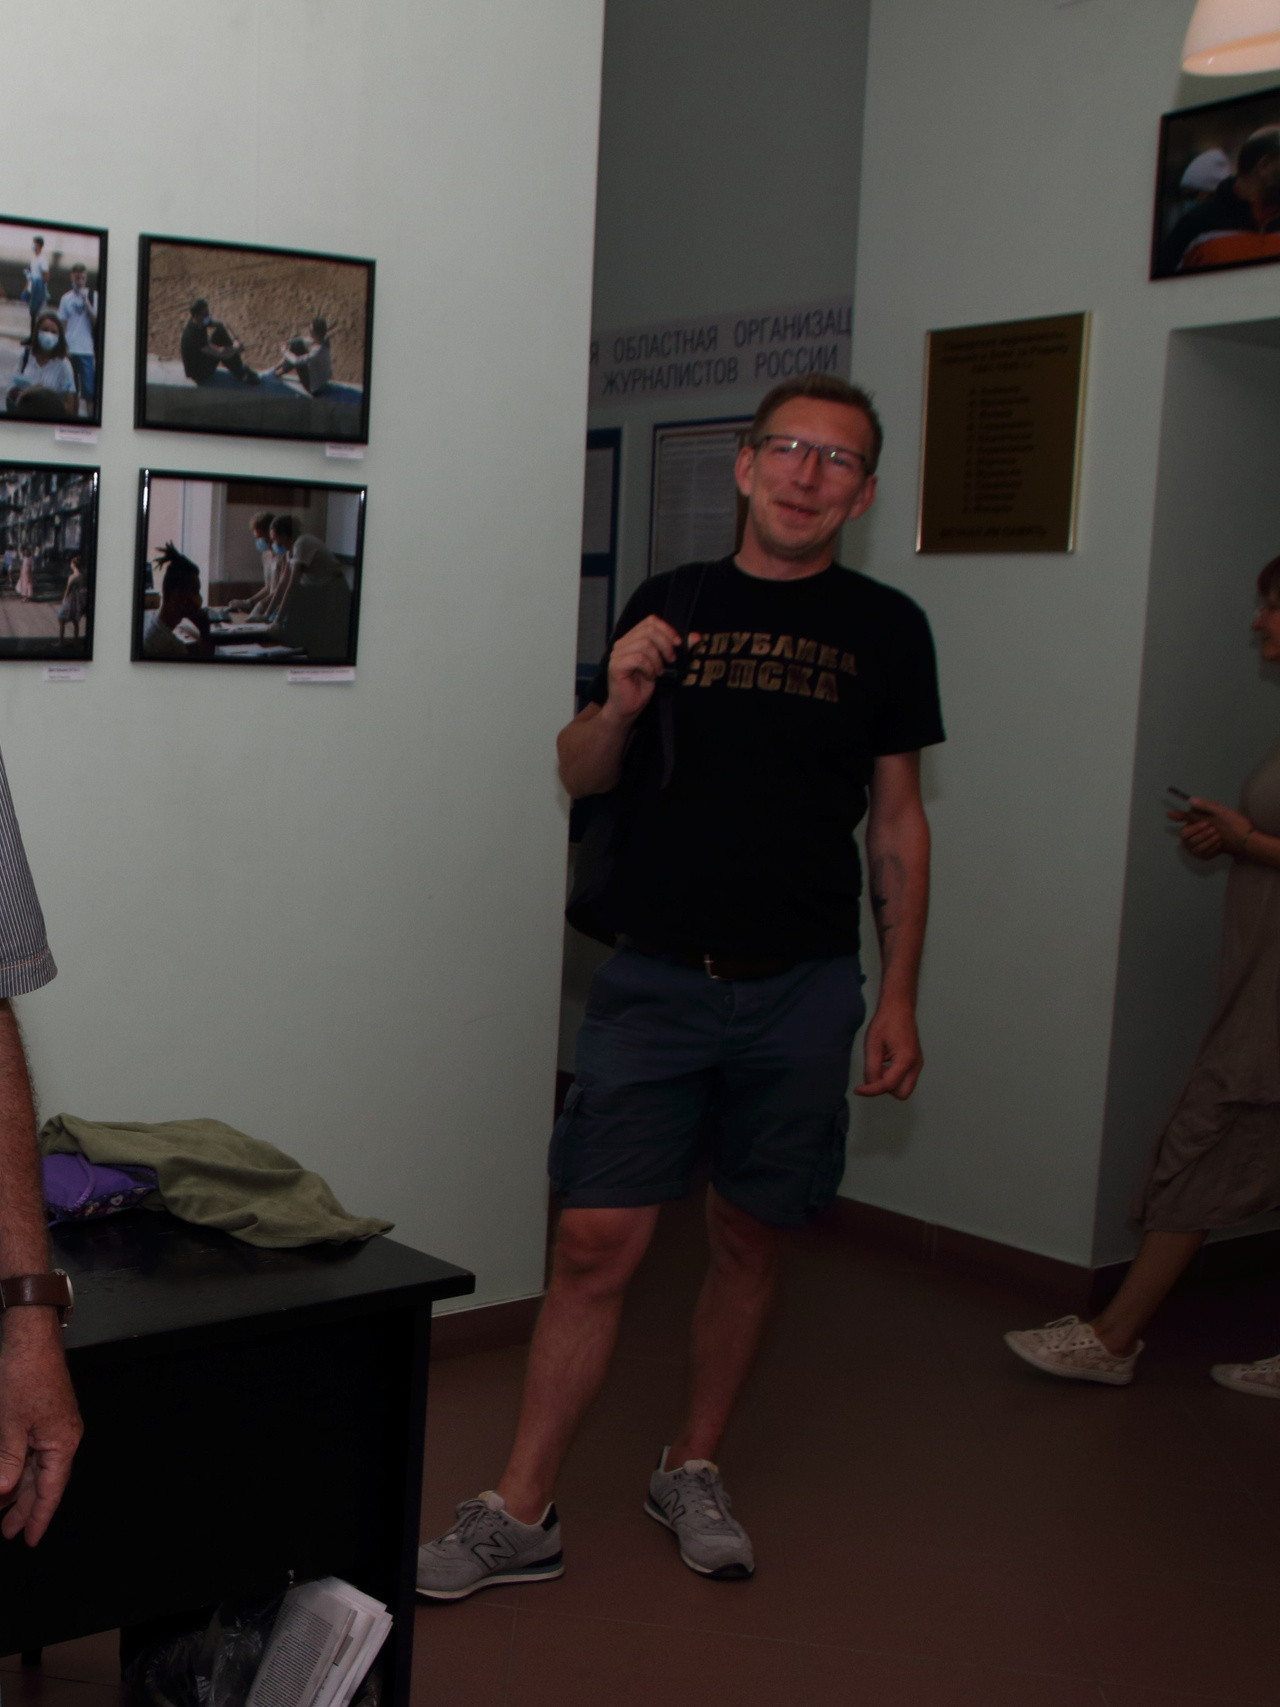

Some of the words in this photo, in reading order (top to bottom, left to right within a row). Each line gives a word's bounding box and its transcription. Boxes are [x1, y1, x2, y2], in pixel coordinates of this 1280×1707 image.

[614, 325, 719, 363] ОБЛАСТНАЯ
[603, 356, 738, 396] ЖУРНАЛИСТОВ
[754, 344, 838, 379] РОССИИ
